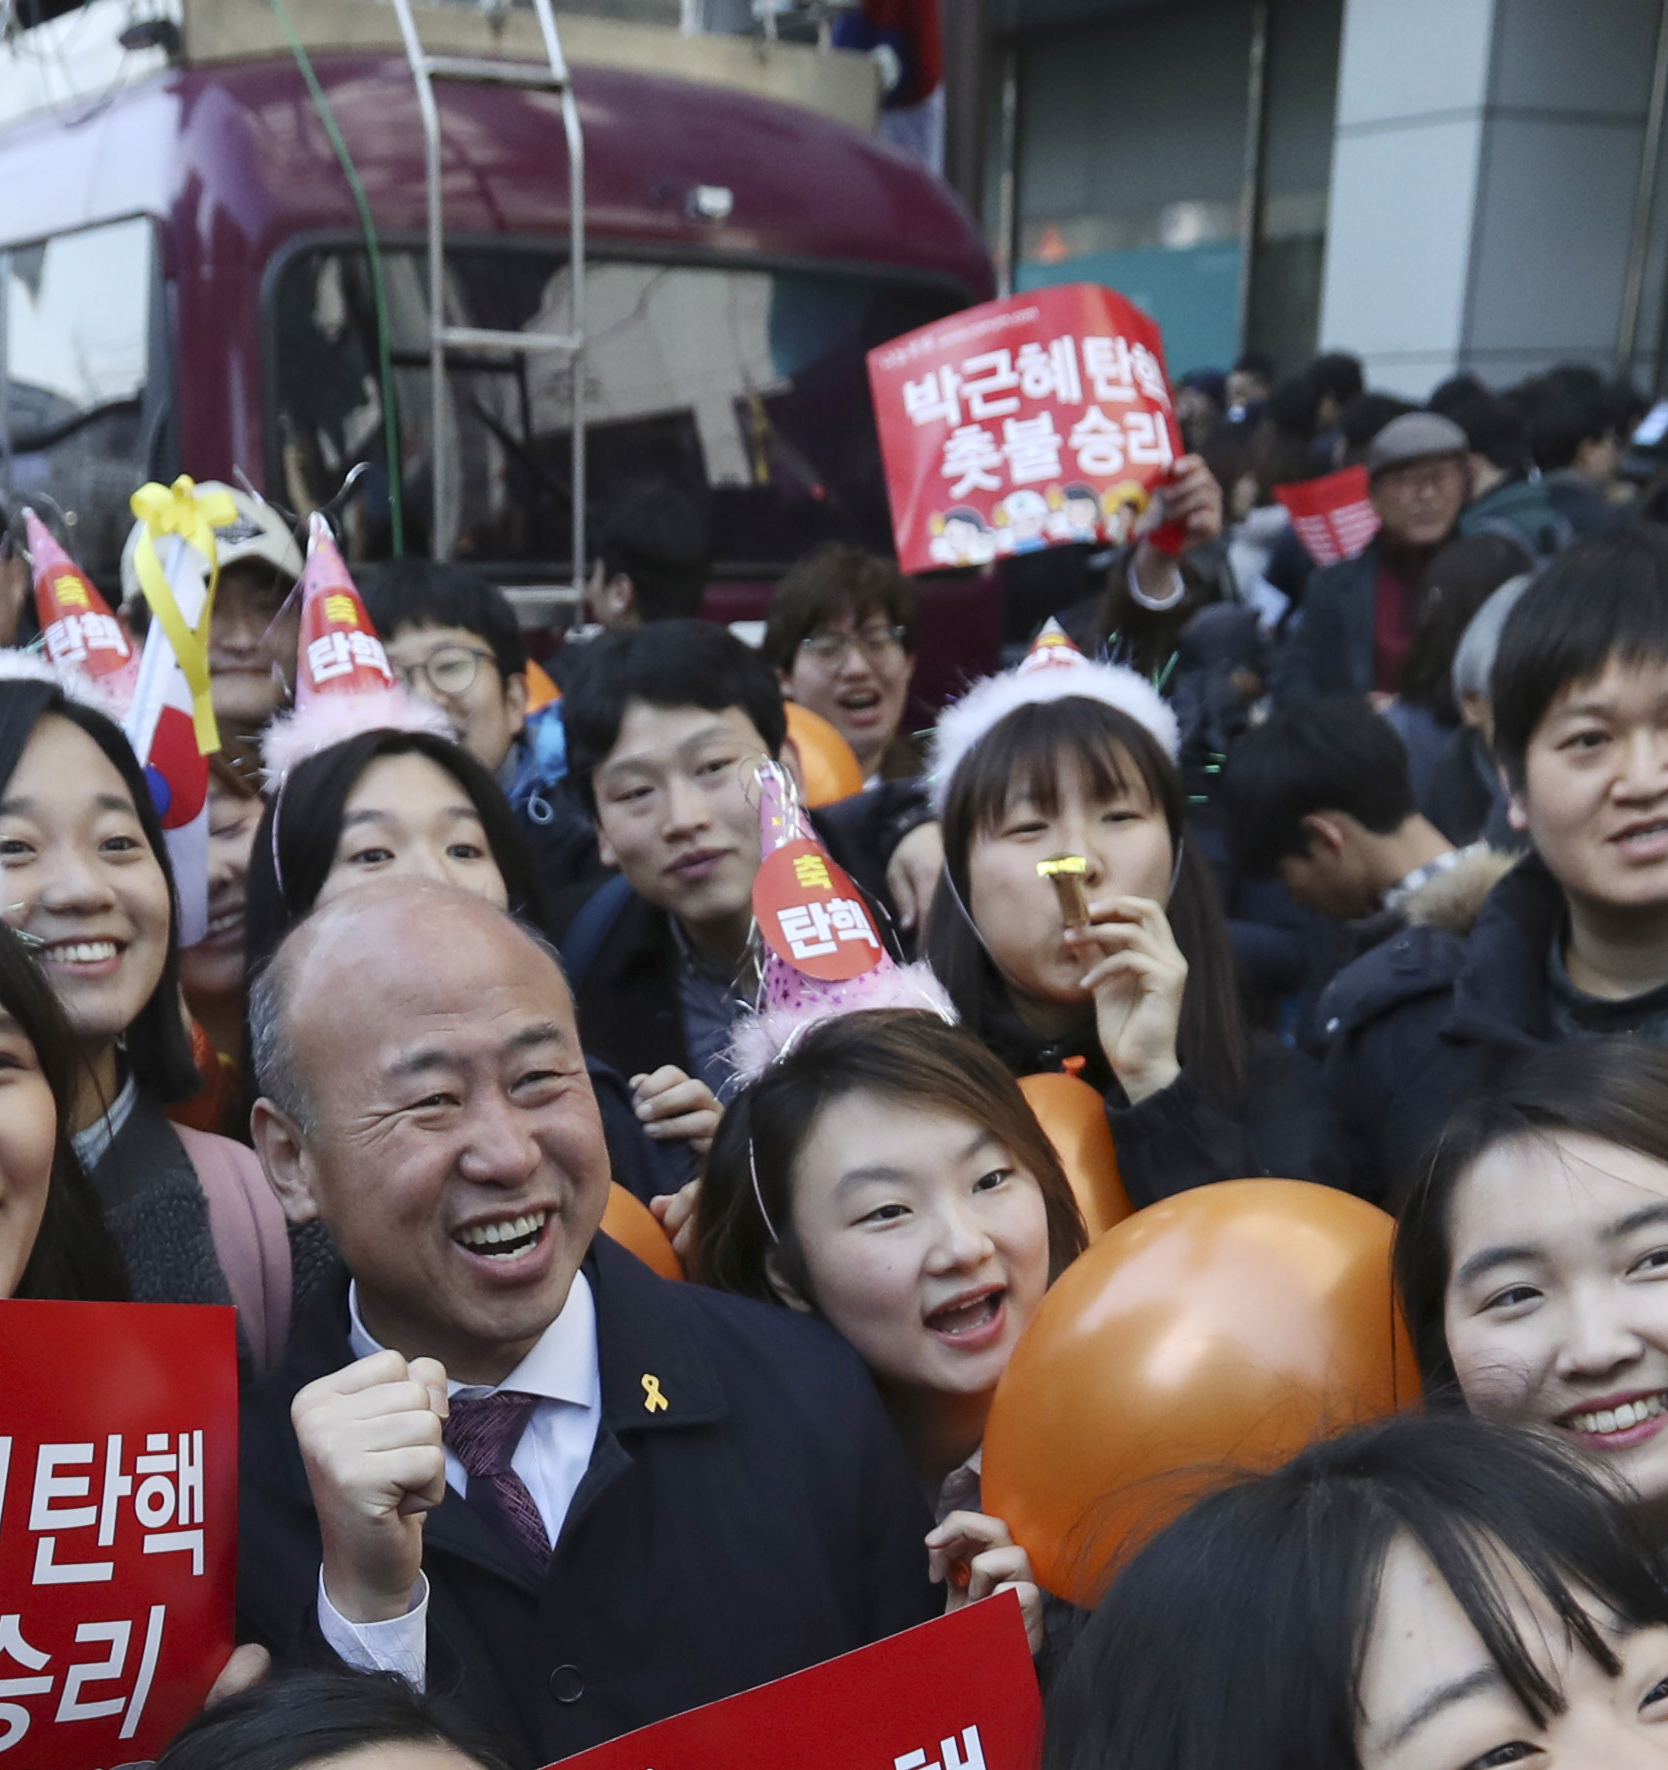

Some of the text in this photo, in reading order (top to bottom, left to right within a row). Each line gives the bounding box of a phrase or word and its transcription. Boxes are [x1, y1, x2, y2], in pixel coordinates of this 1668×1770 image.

[902, 334, 1083, 428] 박근혜
[940, 404, 1175, 500] 촛불 승리
[45, 611, 130, 662] 탄핵
[307, 630, 393, 683] 탄핵
[793, 854, 833, 890] 축
[776, 897, 880, 960] 탄핵
[28, 1430, 205, 1586] 탄핵
